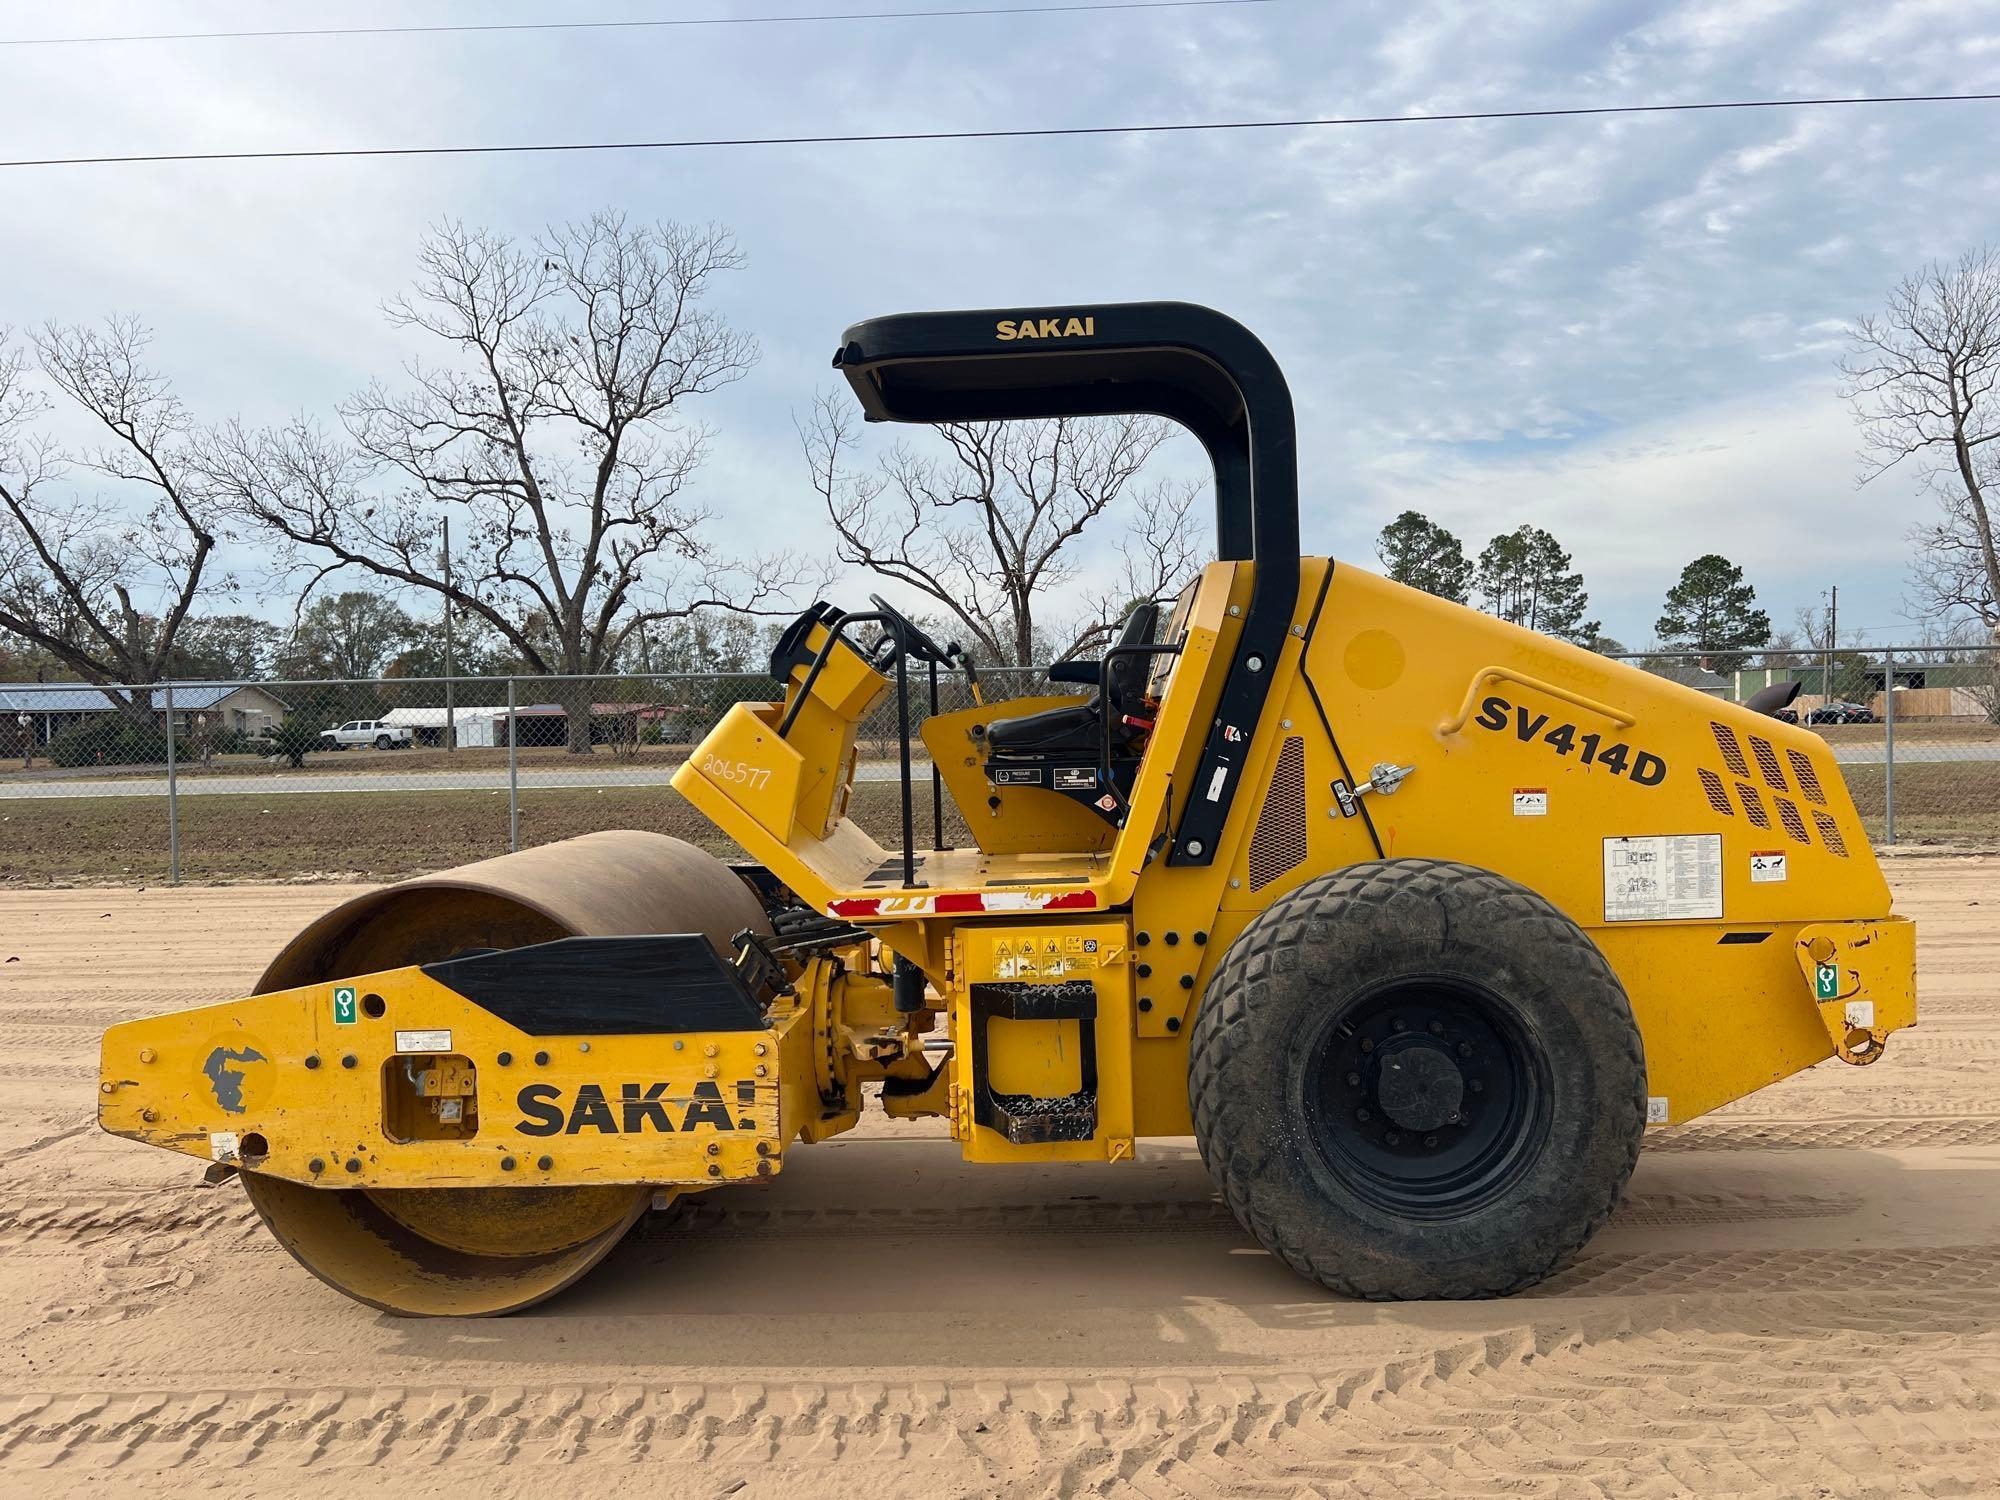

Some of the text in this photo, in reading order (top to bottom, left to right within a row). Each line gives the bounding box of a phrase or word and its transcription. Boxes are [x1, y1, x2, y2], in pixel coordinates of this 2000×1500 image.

[995, 316, 1095, 341] SAKAI
[1474, 696, 1667, 787] SV414D
[703, 753, 772, 791] 206577
[514, 1080, 757, 1137] SAKAI
